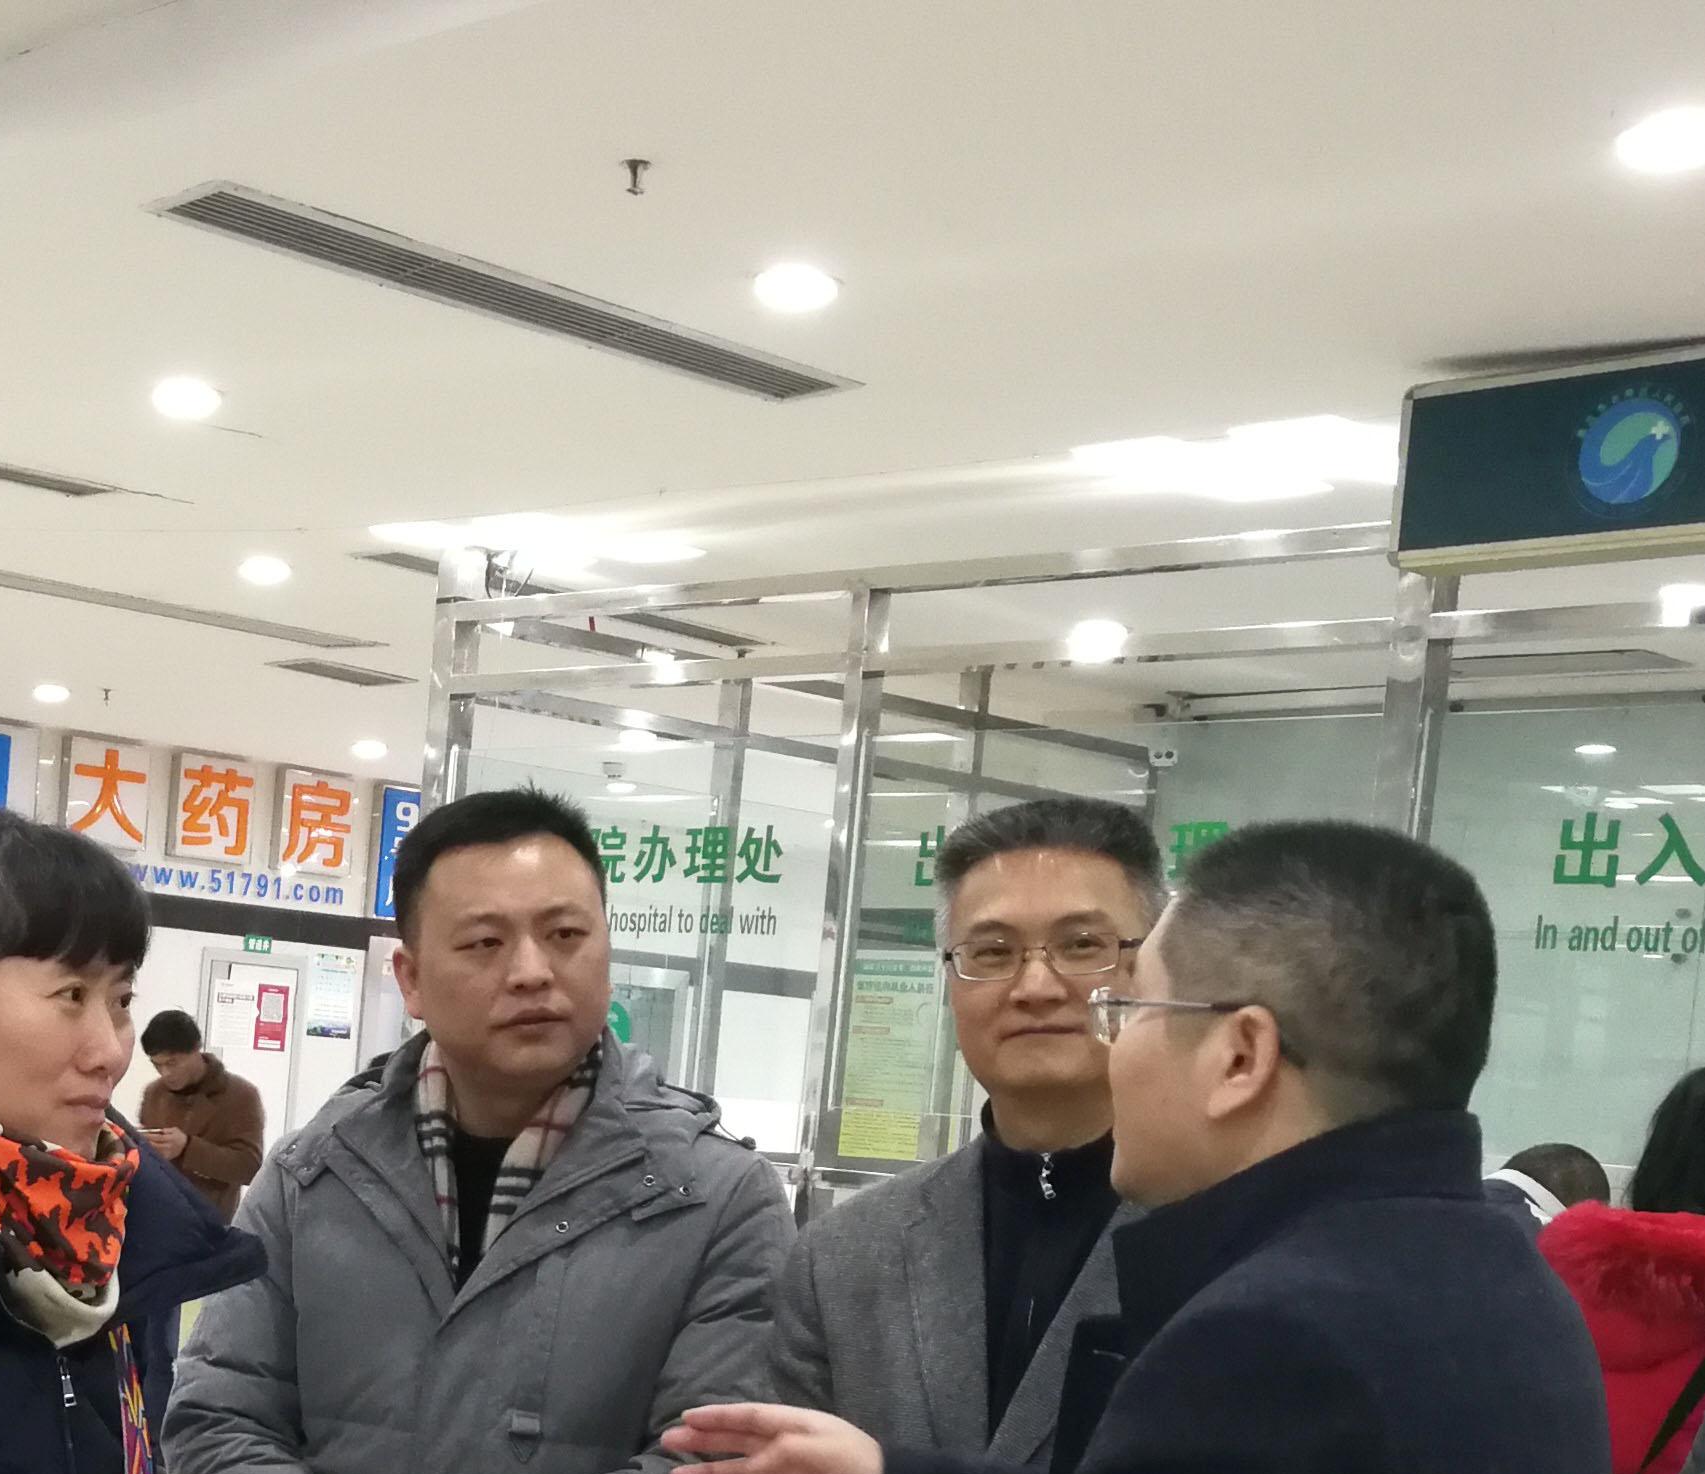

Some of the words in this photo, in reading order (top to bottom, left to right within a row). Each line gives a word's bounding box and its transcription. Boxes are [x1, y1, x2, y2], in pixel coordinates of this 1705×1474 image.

[1553, 811, 1705, 888] 出入
[128, 863, 344, 906] www.51791.com
[609, 904, 673, 939] hospital
[677, 907, 694, 934] to
[699, 905, 734, 935] deal
[739, 906, 778, 936] with
[1535, 914, 1558, 950] In
[1568, 915, 1620, 952] and
[1626, 920, 1674, 953] out
